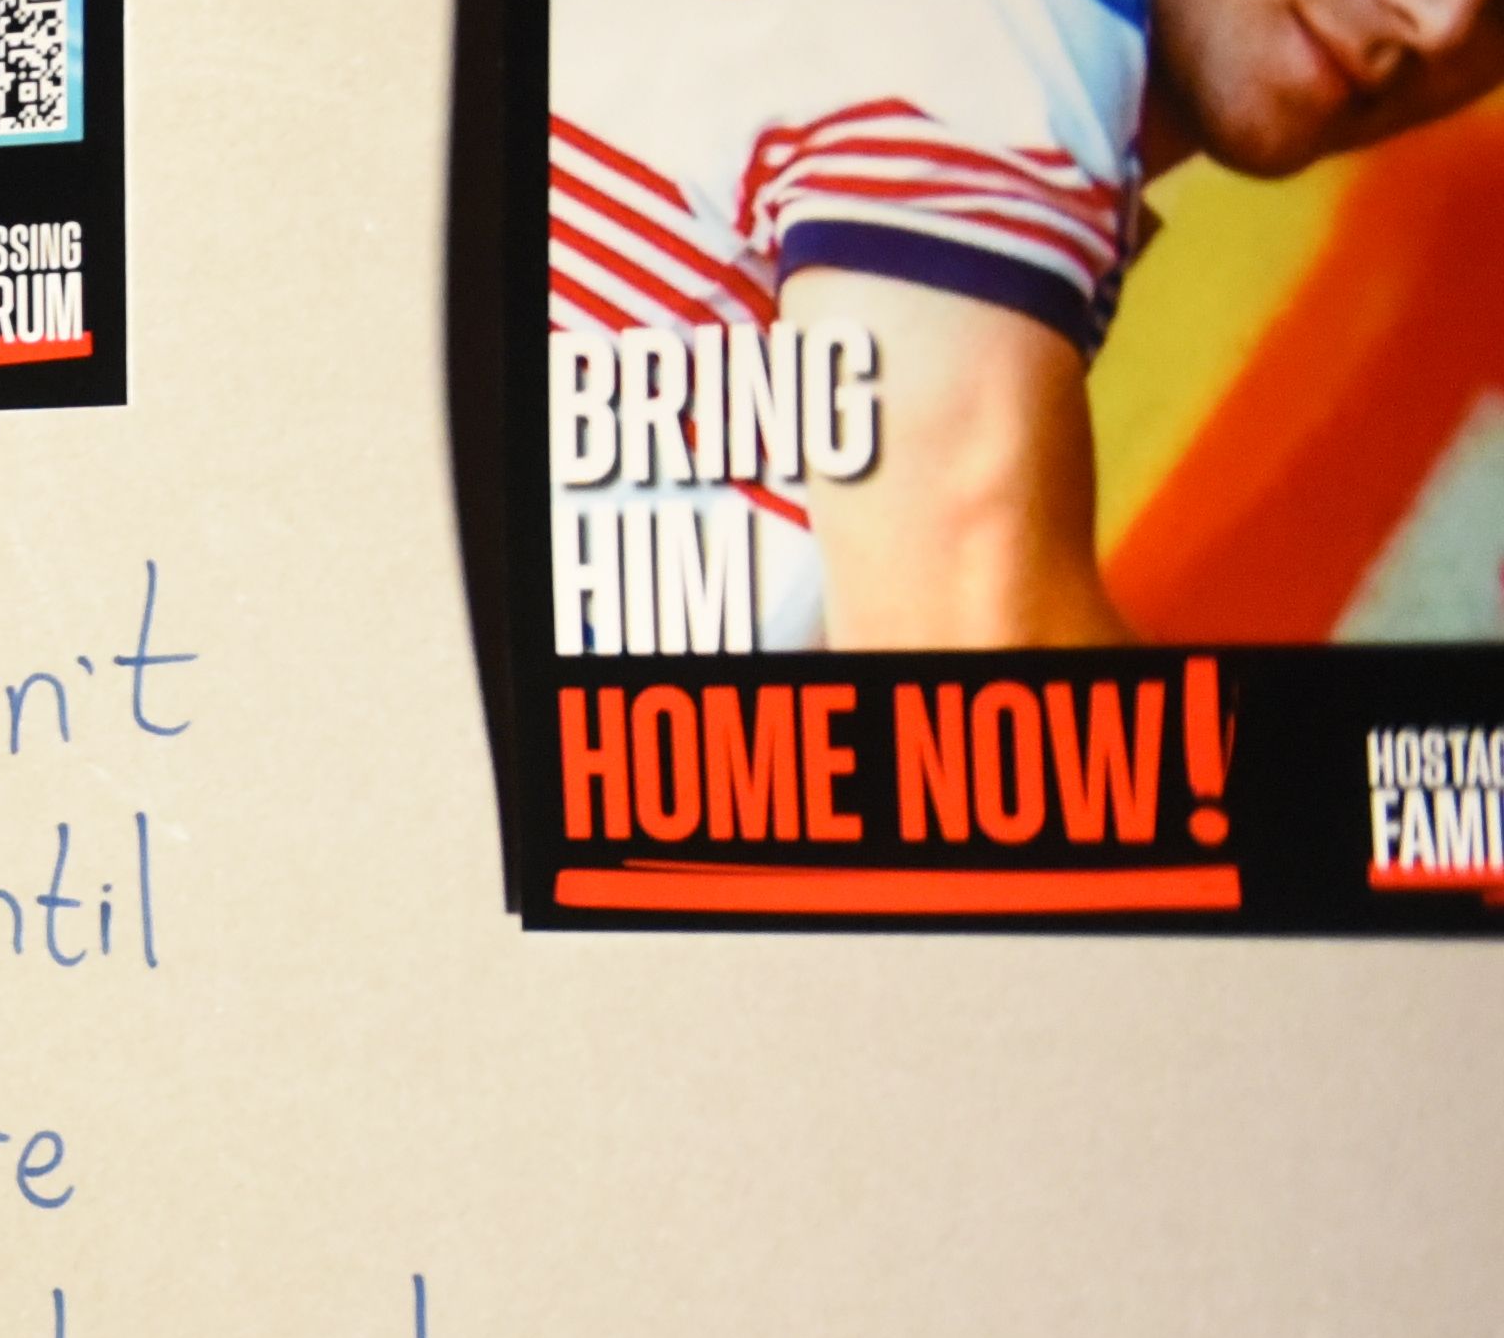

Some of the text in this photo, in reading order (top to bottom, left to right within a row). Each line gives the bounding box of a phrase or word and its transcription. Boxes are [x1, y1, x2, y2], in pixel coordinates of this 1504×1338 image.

[548, 318, 880, 489] BRING
[552, 496, 755, 656] HIM
[557, 655, 1239, 847] HOME NOW!
